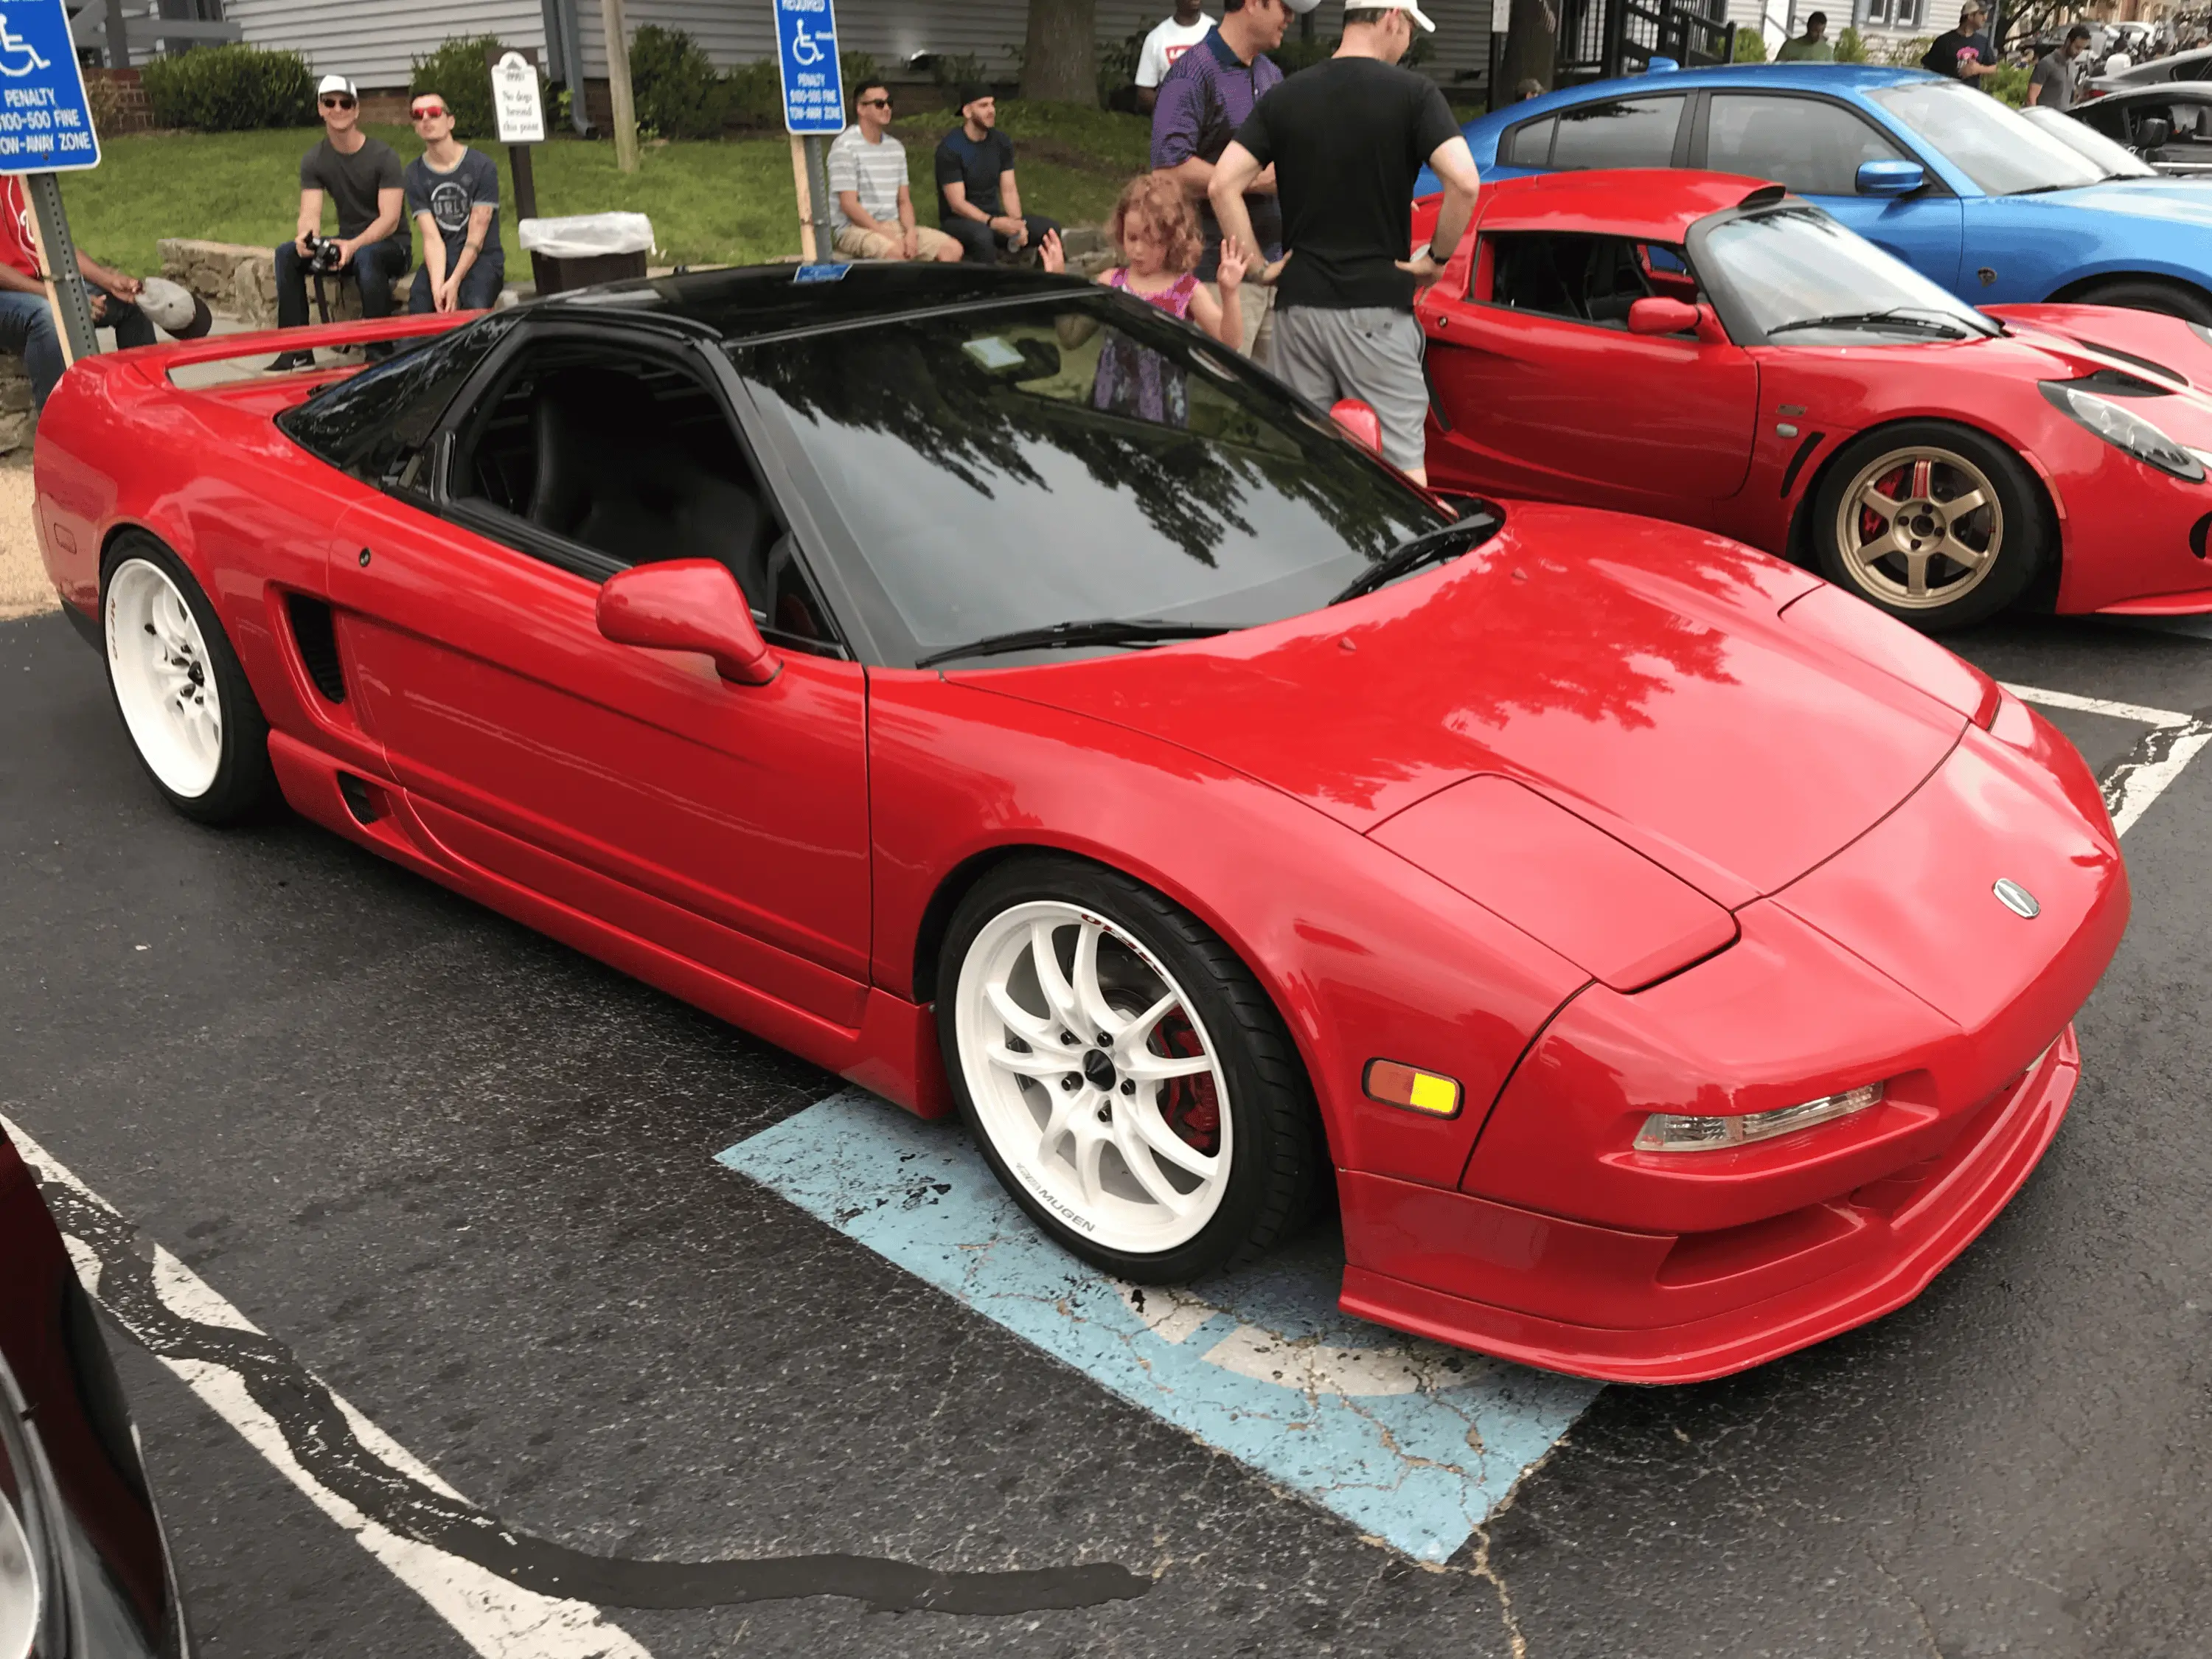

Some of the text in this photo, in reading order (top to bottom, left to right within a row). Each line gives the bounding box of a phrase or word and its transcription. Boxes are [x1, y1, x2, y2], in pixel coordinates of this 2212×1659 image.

[4, 87, 55, 108] PENALTY
[0, 108, 81, 132] 100-500 FINE
[58, 131, 92, 151] ZONE
[1038, 1189, 1096, 1232] MUGEN
